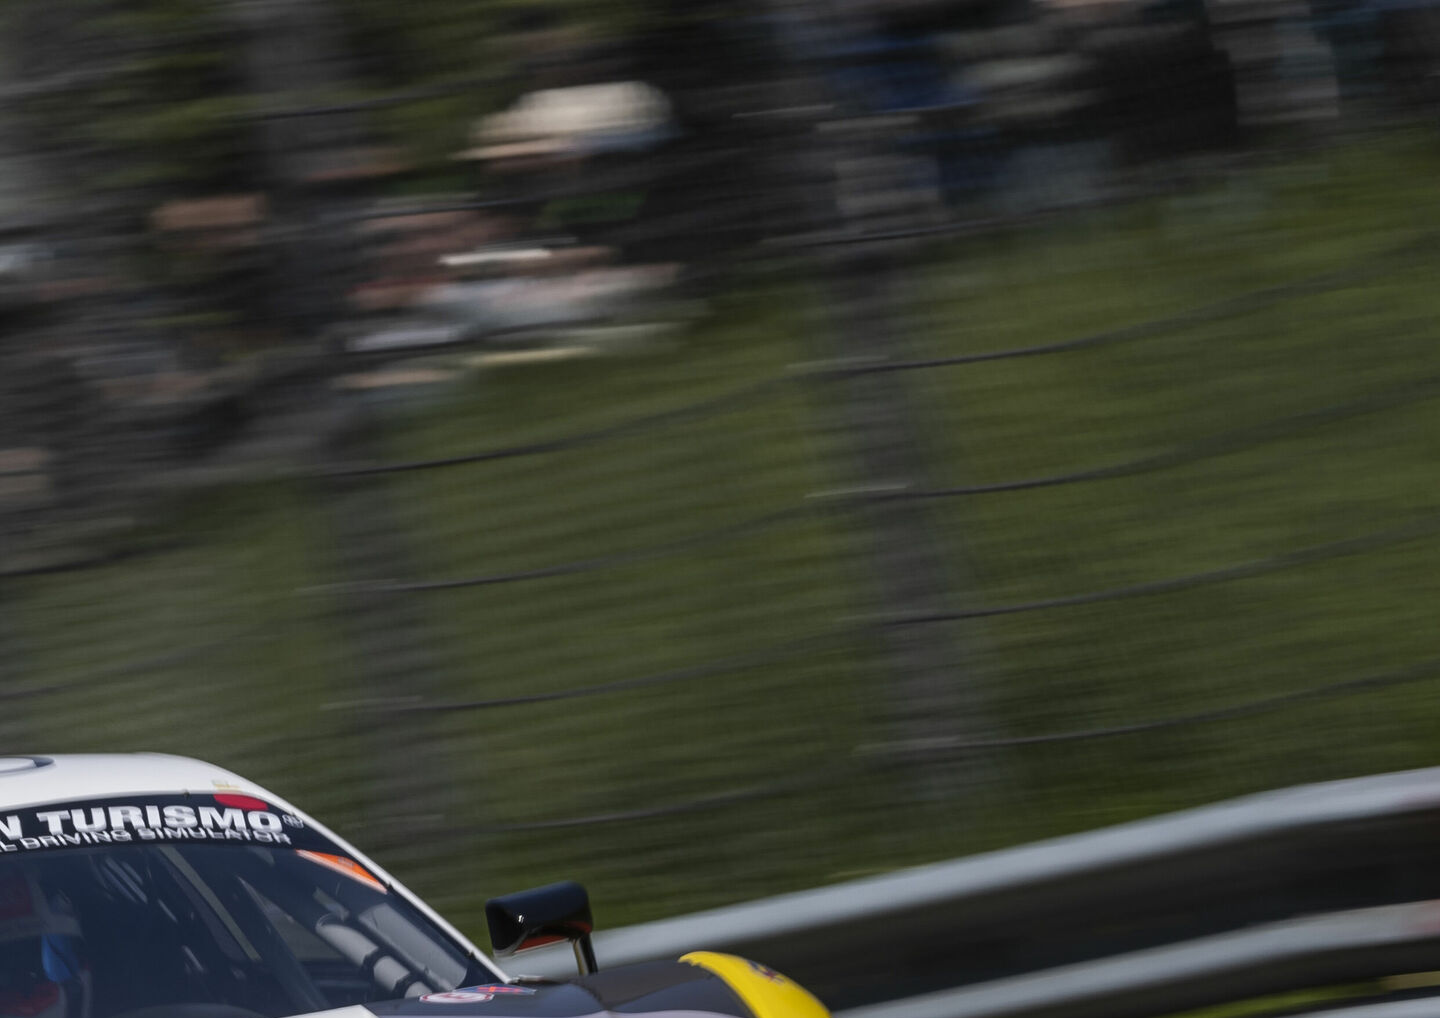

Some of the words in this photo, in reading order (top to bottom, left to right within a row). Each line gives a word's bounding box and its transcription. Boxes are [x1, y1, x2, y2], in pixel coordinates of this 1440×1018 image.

[37, 804, 284, 835] TURISMO
[20, 829, 133, 850] DRIVING
[138, 827, 292, 845] SIMULATOR
